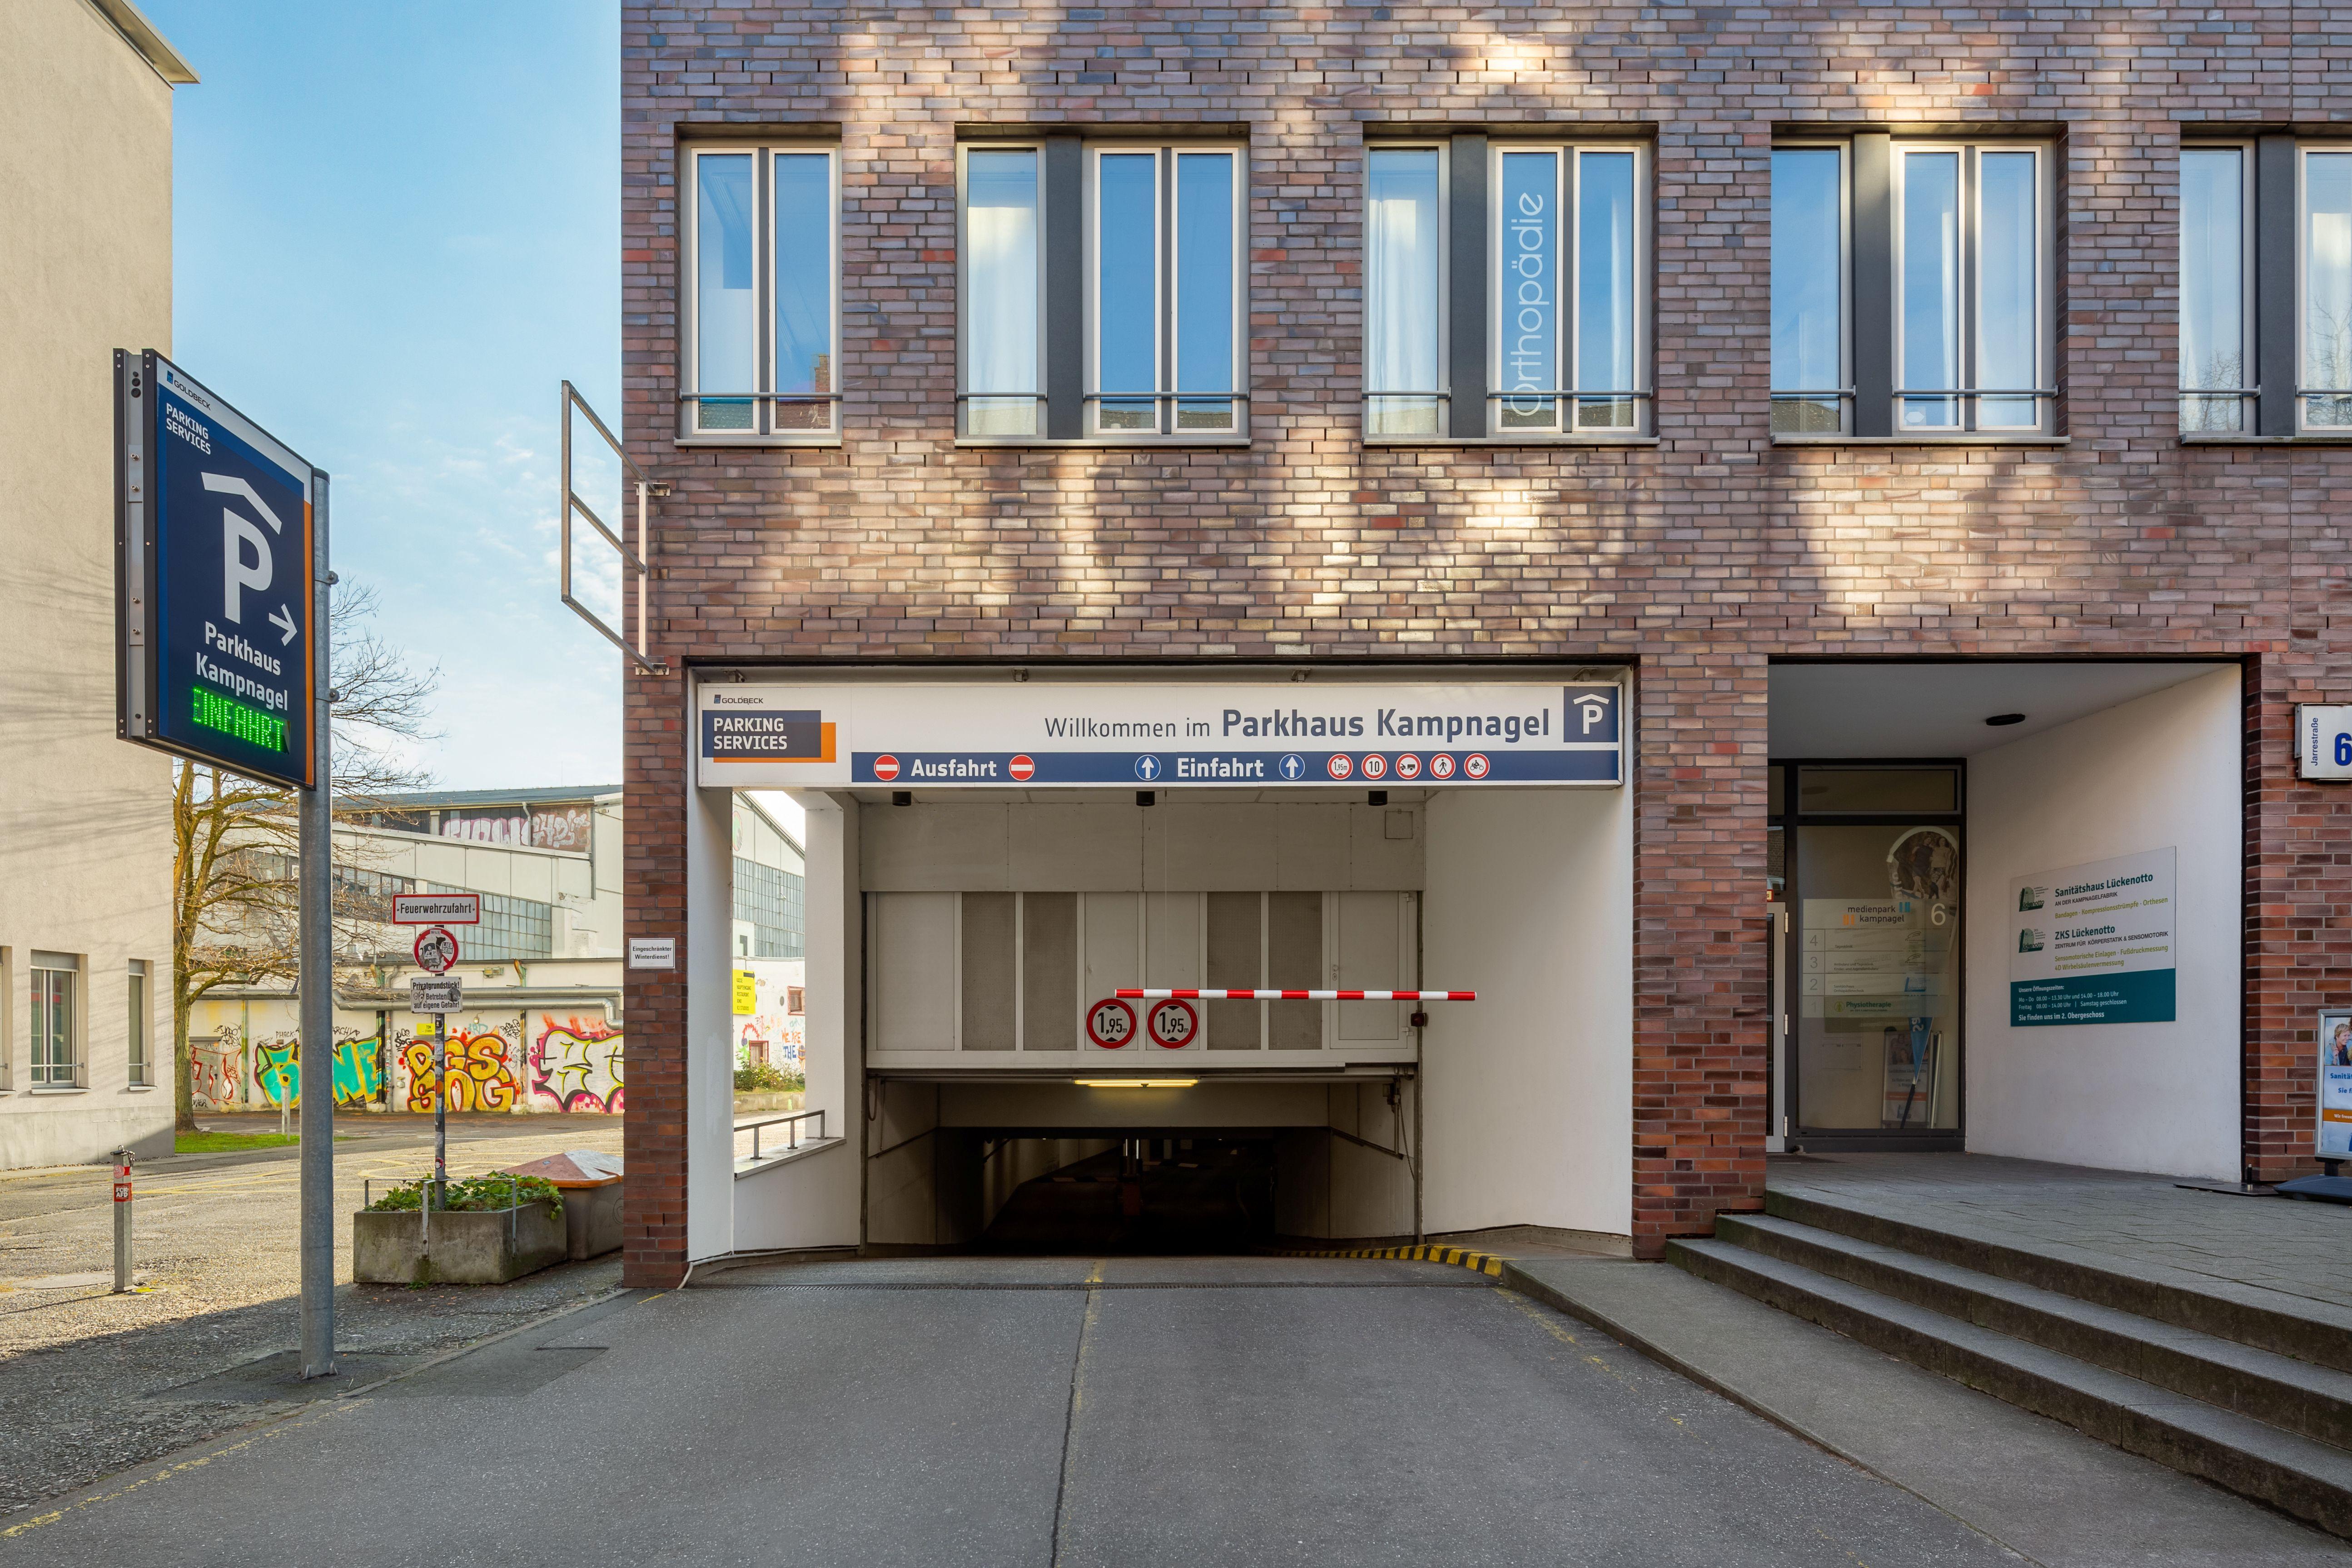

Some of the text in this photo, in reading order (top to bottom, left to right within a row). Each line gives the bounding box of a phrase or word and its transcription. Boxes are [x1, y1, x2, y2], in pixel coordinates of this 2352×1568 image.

[1510, 192, 1550, 416] Orthopädie
[174, 379, 211, 410] GOLDBECK
[166, 403, 209, 440] PARKING
[166, 418, 211, 455] SERVICES
[205, 621, 281, 676] Parkhaus
[196, 652, 288, 711] Kampnagel
[193, 685, 284, 752] EINFAHRT
[714, 718, 784, 732] PARKING
[1045, 709, 1549, 743] Willkommen im Parkhaus Kampnagel
[714, 736, 787, 750] SERVICES
[911, 759, 997, 777] Ausfahrt
[1178, 757, 1264, 777] Einfahrt
[1369, 761, 1380, 772] 10
[2055, 882, 2104, 898] Sanitätshaus
[2107, 873, 2153, 888] Lückenotto
[2072, 892, 2118, 904] KAMPNAGELFABRIK
[2082, 901, 2138, 915] Kompressionsstrümpfe
[2143, 897, 2168, 906] Orthesen
[400, 903, 471, 914] Feuerwehrzufahrt
[1848, 905, 1895, 914] medienpark
[1931, 903, 1946, 926] 6
[1860, 914, 1904, 923] kampnagel
[1810, 935, 1818, 946] 4
[2055, 930, 2069, 940] ZKS
[2072, 925, 2115, 938] Lückenotto
[2088, 936, 2122, 946] KÖRPERSTATIK
[2128, 931, 2168, 941] SENSOMOTORIK
[2055, 945, 2168, 962] Sensomotorische Einlagen Fußdruckmessung
[1810, 957, 1818, 969] 3
[2062, 960, 2124, 970] Wirbelsäulenvermessung
[413, 981, 459, 990] Privatgrundstück!
[1810, 979, 1818, 990] 2
[1098, 1012, 1127, 1035] 1,95m
[1159, 1012, 1189, 1034] 1,95m
[2068, 1011, 2104, 1020] Obergeschoss
